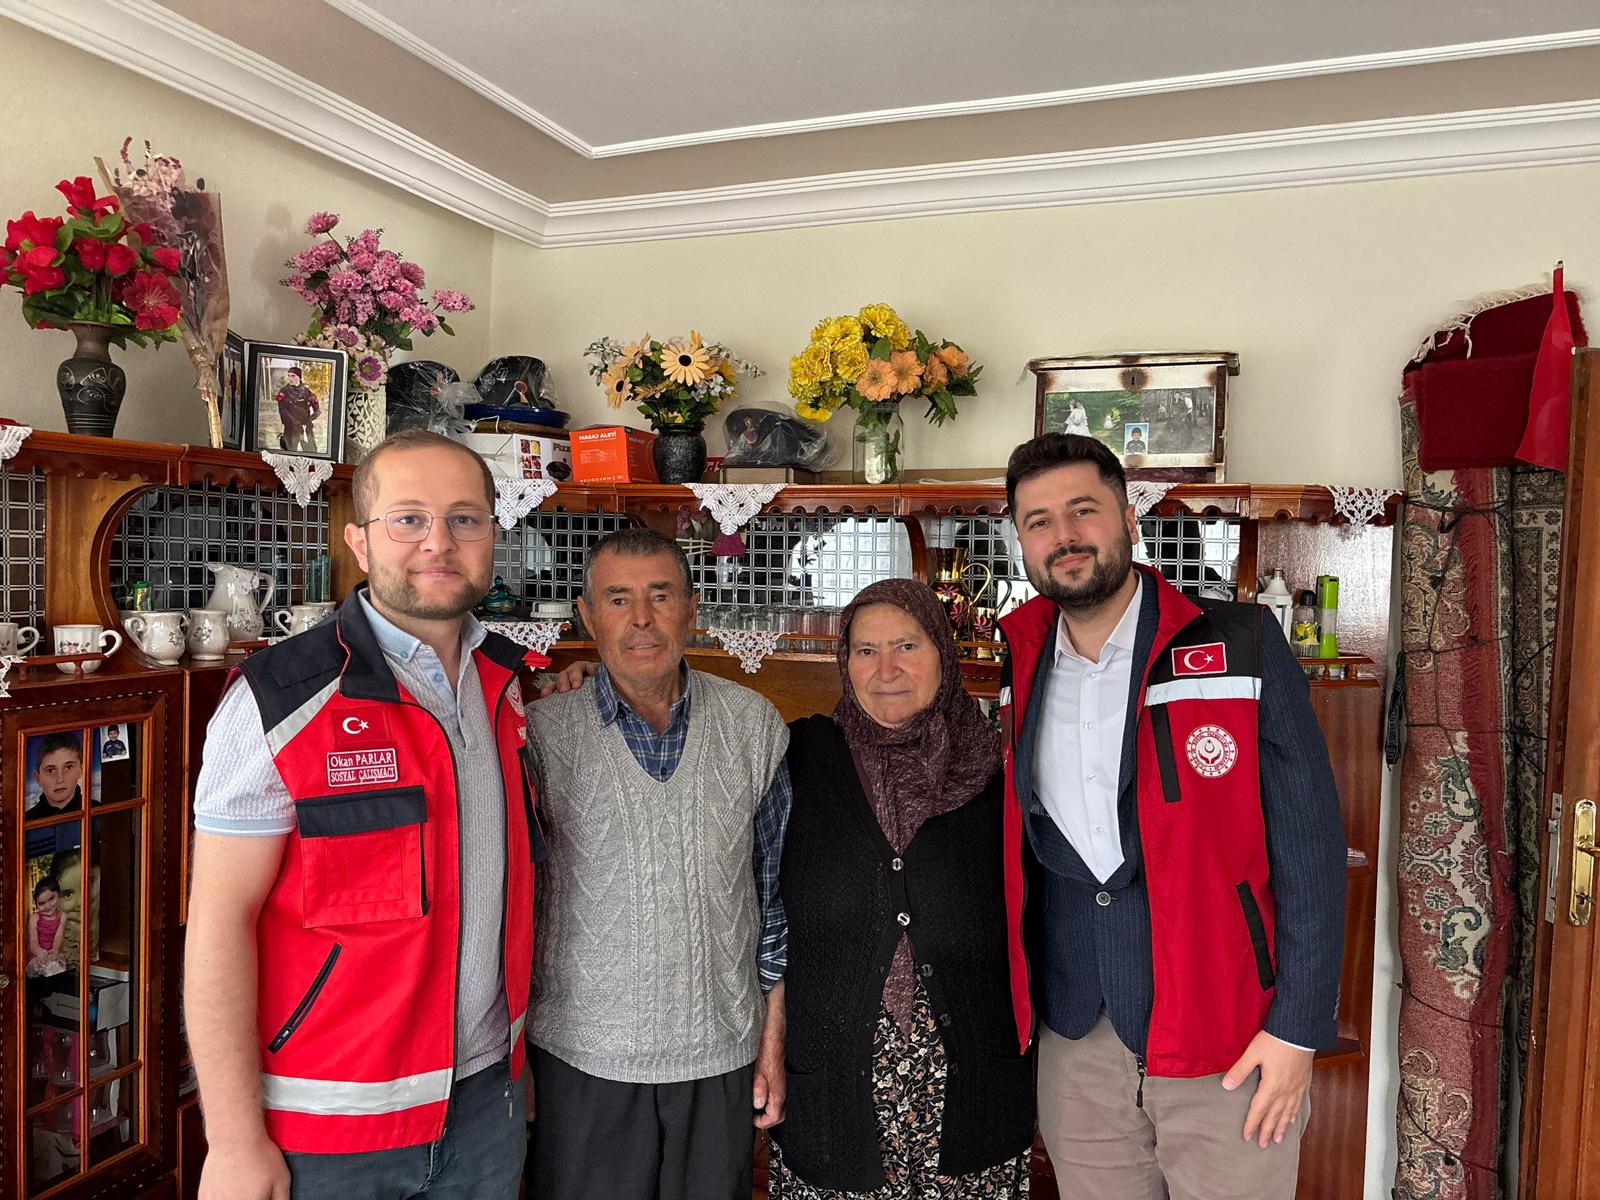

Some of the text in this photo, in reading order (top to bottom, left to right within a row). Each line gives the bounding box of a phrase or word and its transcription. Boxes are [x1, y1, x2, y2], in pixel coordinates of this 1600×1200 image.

[330, 752, 393, 768] Okan PARLAR
[331, 767, 395, 783] SOSYAL ÇALIŞMACI
